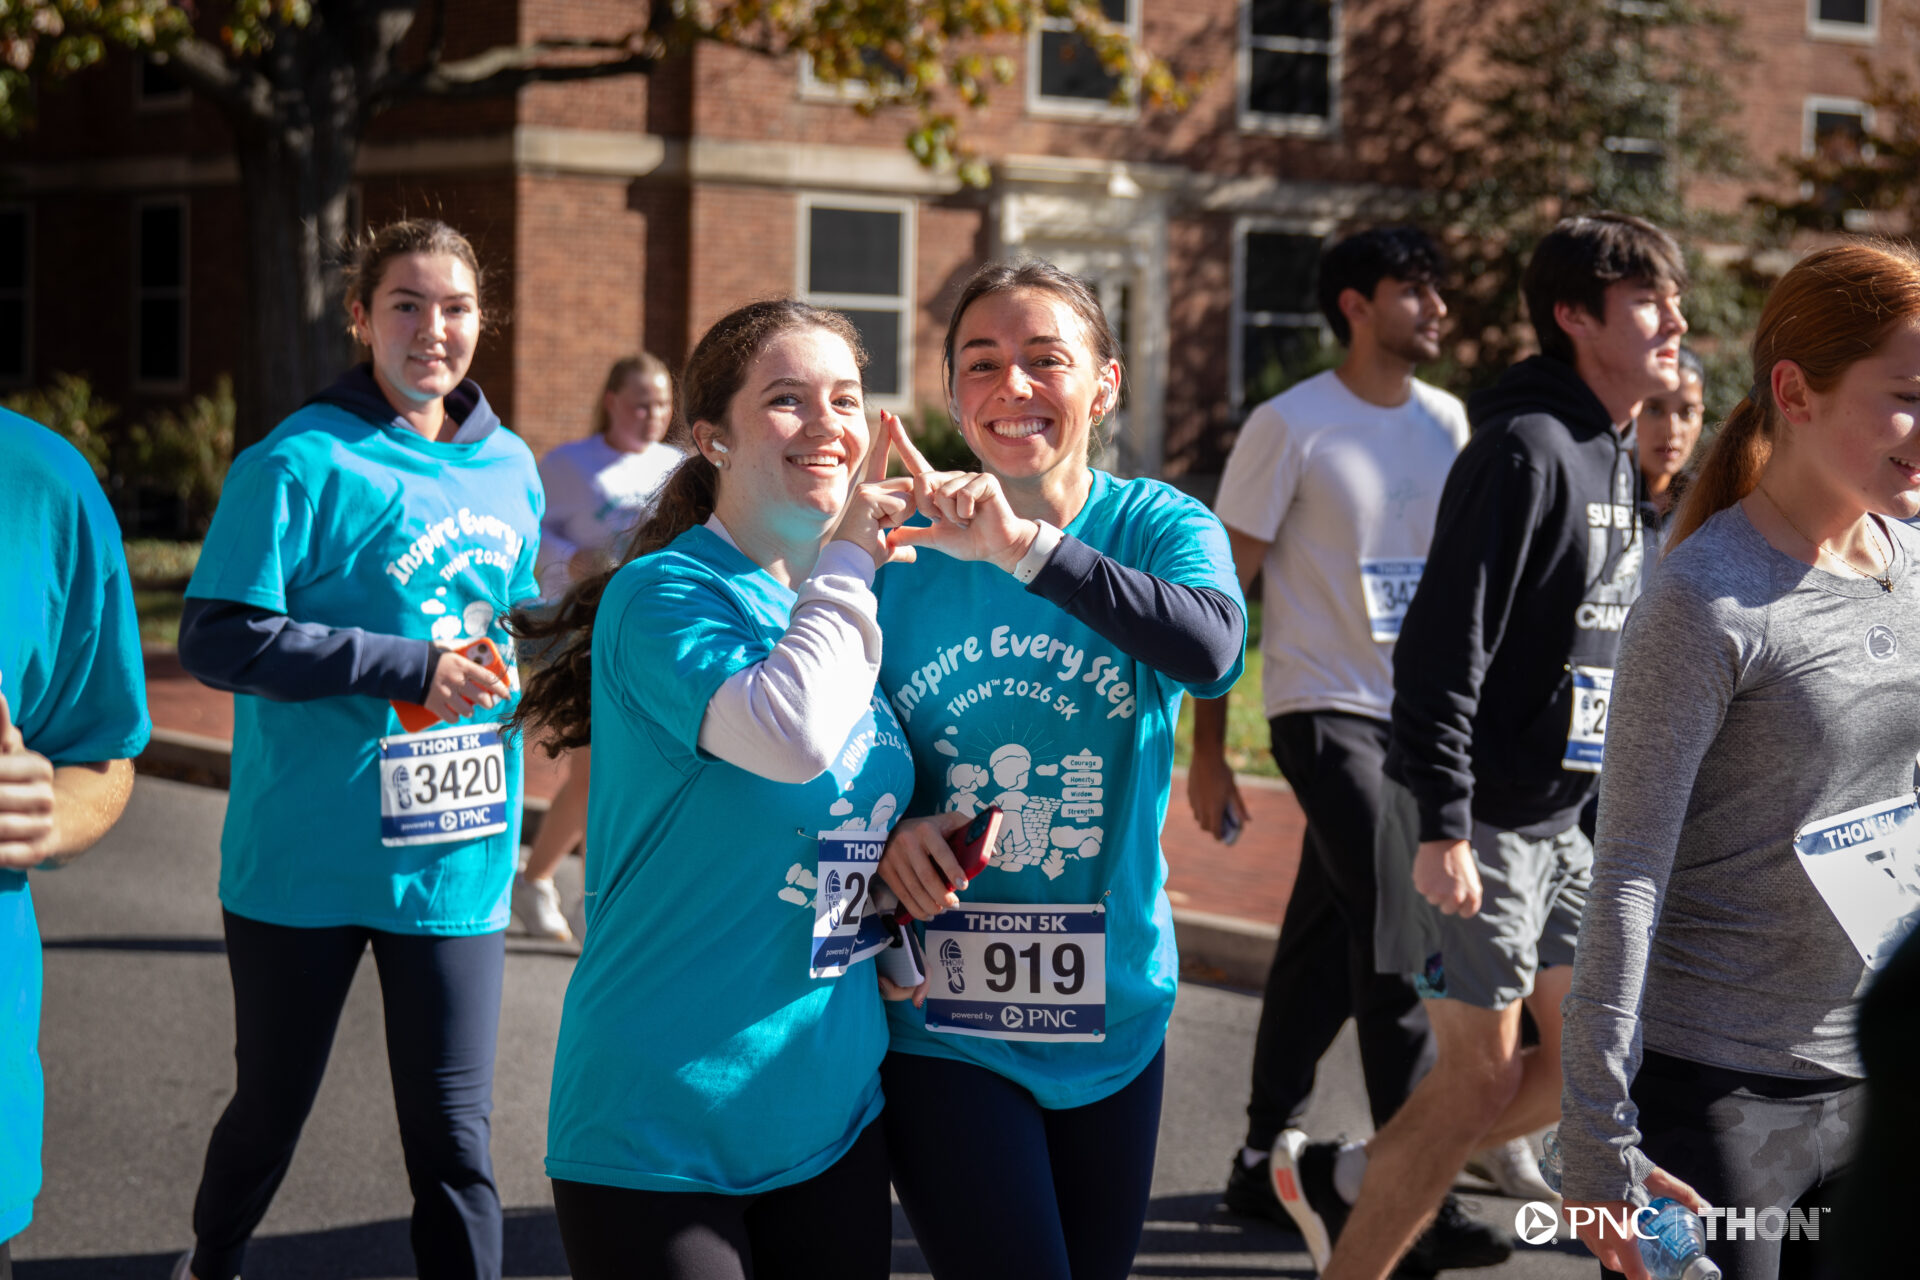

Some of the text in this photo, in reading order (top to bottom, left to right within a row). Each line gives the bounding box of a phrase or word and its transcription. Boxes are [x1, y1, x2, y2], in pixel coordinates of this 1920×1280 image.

[386, 507, 517, 586] Inspire Every
[892, 625, 1136, 723] Inspire Every Step
[1003, 677, 1053, 703] 2026
[1053, 694, 1080, 721] 5K
[410, 734, 481, 756] THON 5K
[867, 730, 902, 750] 2026
[1070, 759, 1097, 768] Courage
[415, 754, 502, 804] 3420
[459, 807, 491, 828] PNC
[1877, 812, 1898, 836] 5K
[1038, 915, 1068, 932] 5K
[940, 959, 965, 967] THON
[951, 966, 964, 974] 5K
[983, 942, 1086, 995] 919
[951, 1011, 994, 1021] powered by
[1026, 1008, 1078, 1029] PNC
